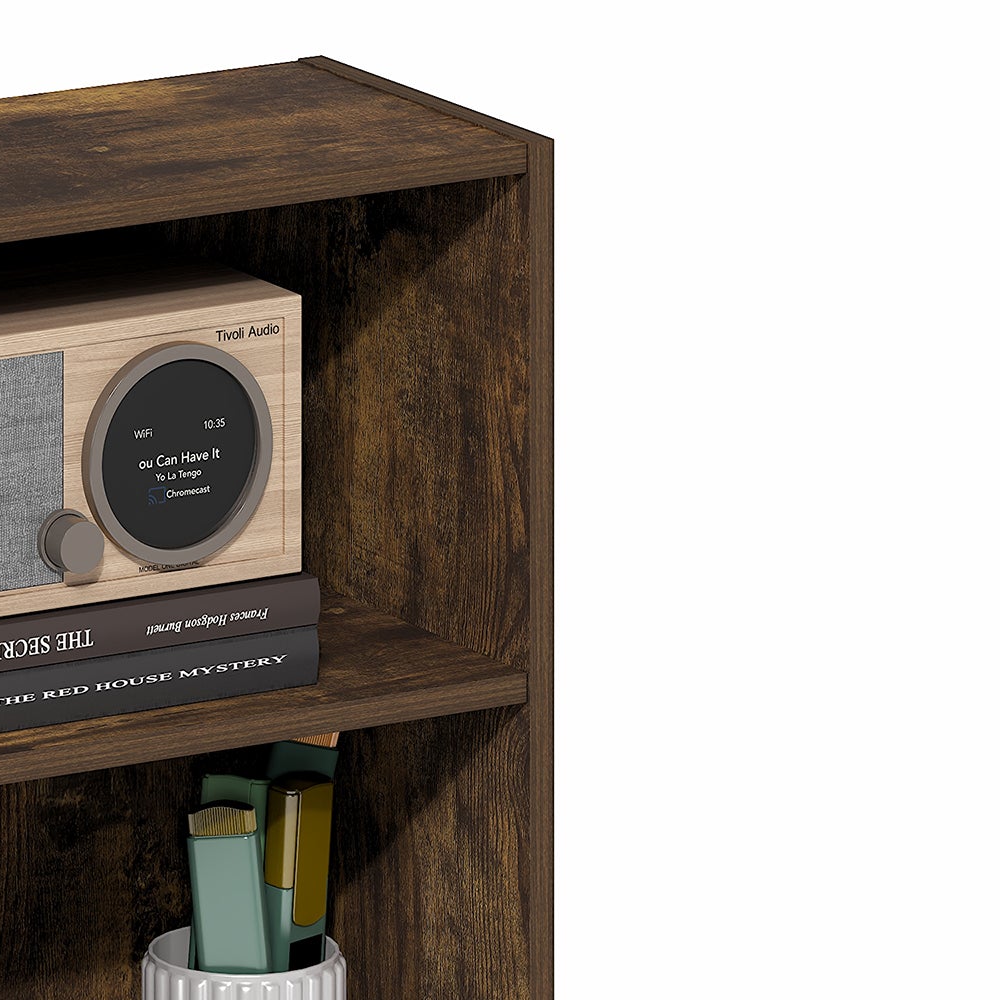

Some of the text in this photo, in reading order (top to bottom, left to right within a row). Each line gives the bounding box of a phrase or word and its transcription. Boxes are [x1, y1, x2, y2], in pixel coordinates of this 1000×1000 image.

[215, 323, 280, 342] Tivoli Audio
[203, 417, 226, 430] 10:35
[133, 428, 153, 440] WiFi
[138, 447, 221, 470] ou Can Have It
[155, 469, 202, 482] Yo La Tengo
[166, 485, 211, 499] Chromecast
[138, 564, 161, 573] MODEL
[146, 607, 269, 636] Frances Hodgson Burnett
[56, 629, 94, 651] THE
[42, 685, 89, 700] RED
[95, 672, 173, 692] HOUSE
[178, 654, 288, 679] MYSTERY
